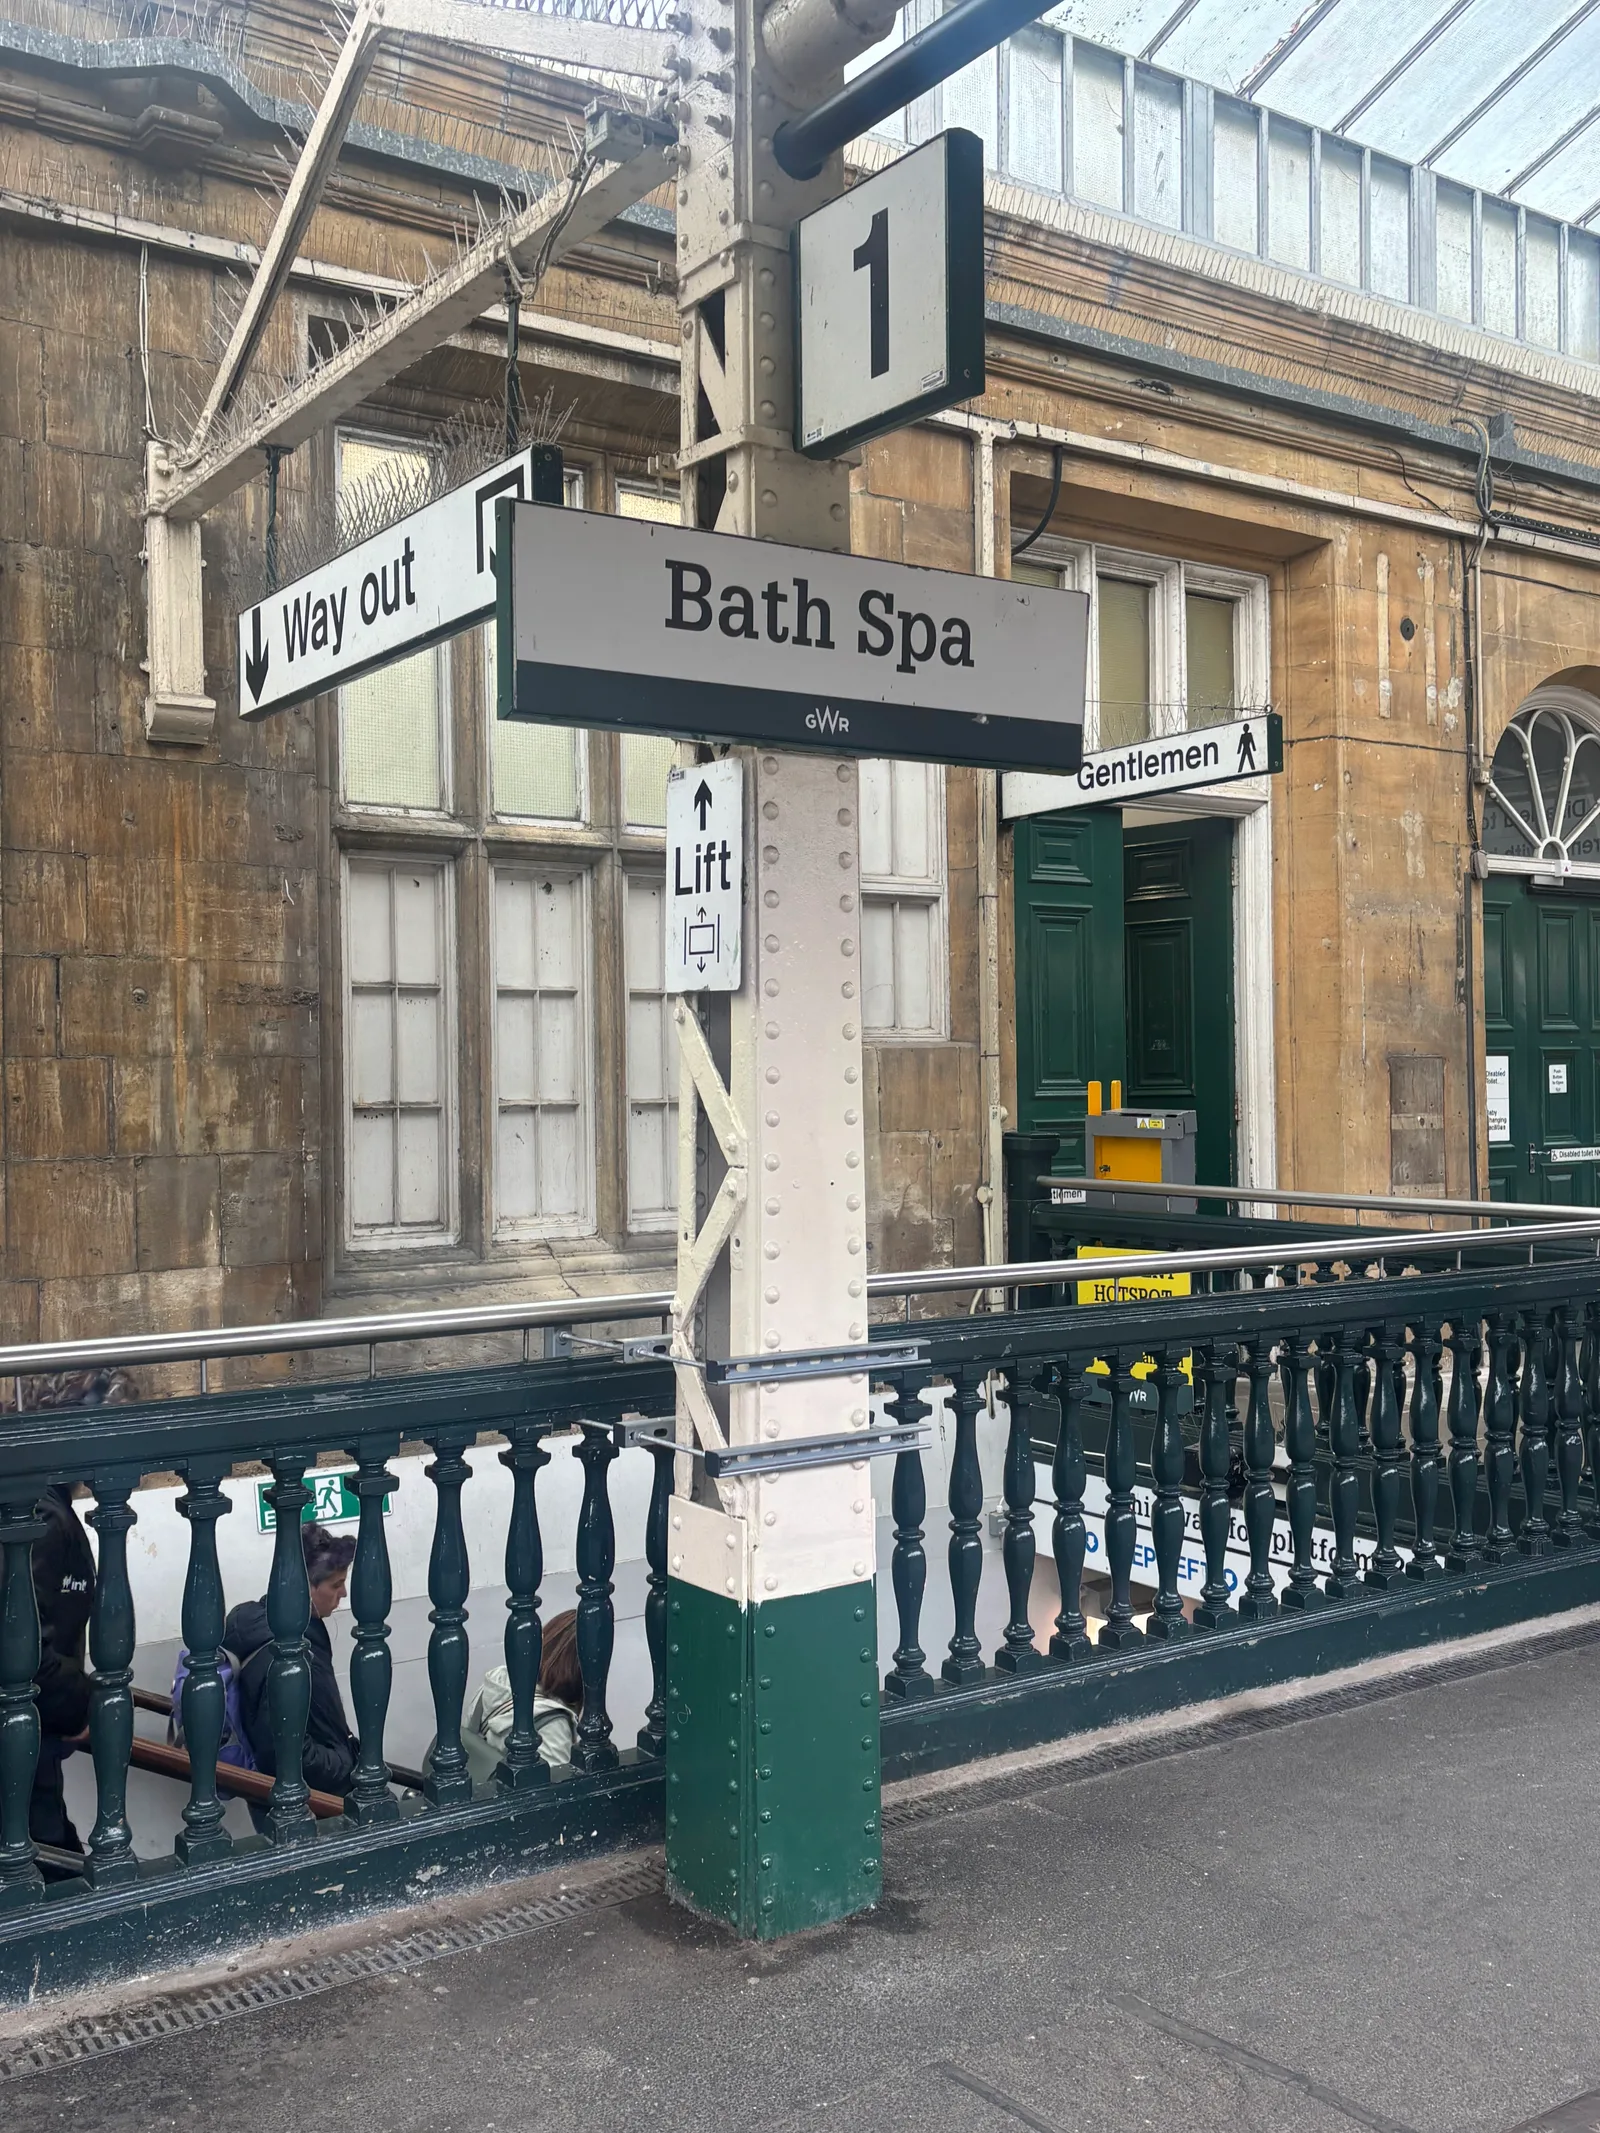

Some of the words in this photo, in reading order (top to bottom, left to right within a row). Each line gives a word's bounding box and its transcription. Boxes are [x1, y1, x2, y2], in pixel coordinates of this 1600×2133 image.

[854, 207, 889, 379] 1
[282, 586, 348, 663] Way
[360, 536, 416, 626] out
[665, 559, 835, 649] Bath
[857, 589, 975, 674] Spa
[805, 705, 850, 735] GWR
[1077, 741, 1219, 790] Gentlemen
[675, 840, 731, 896] Lift
